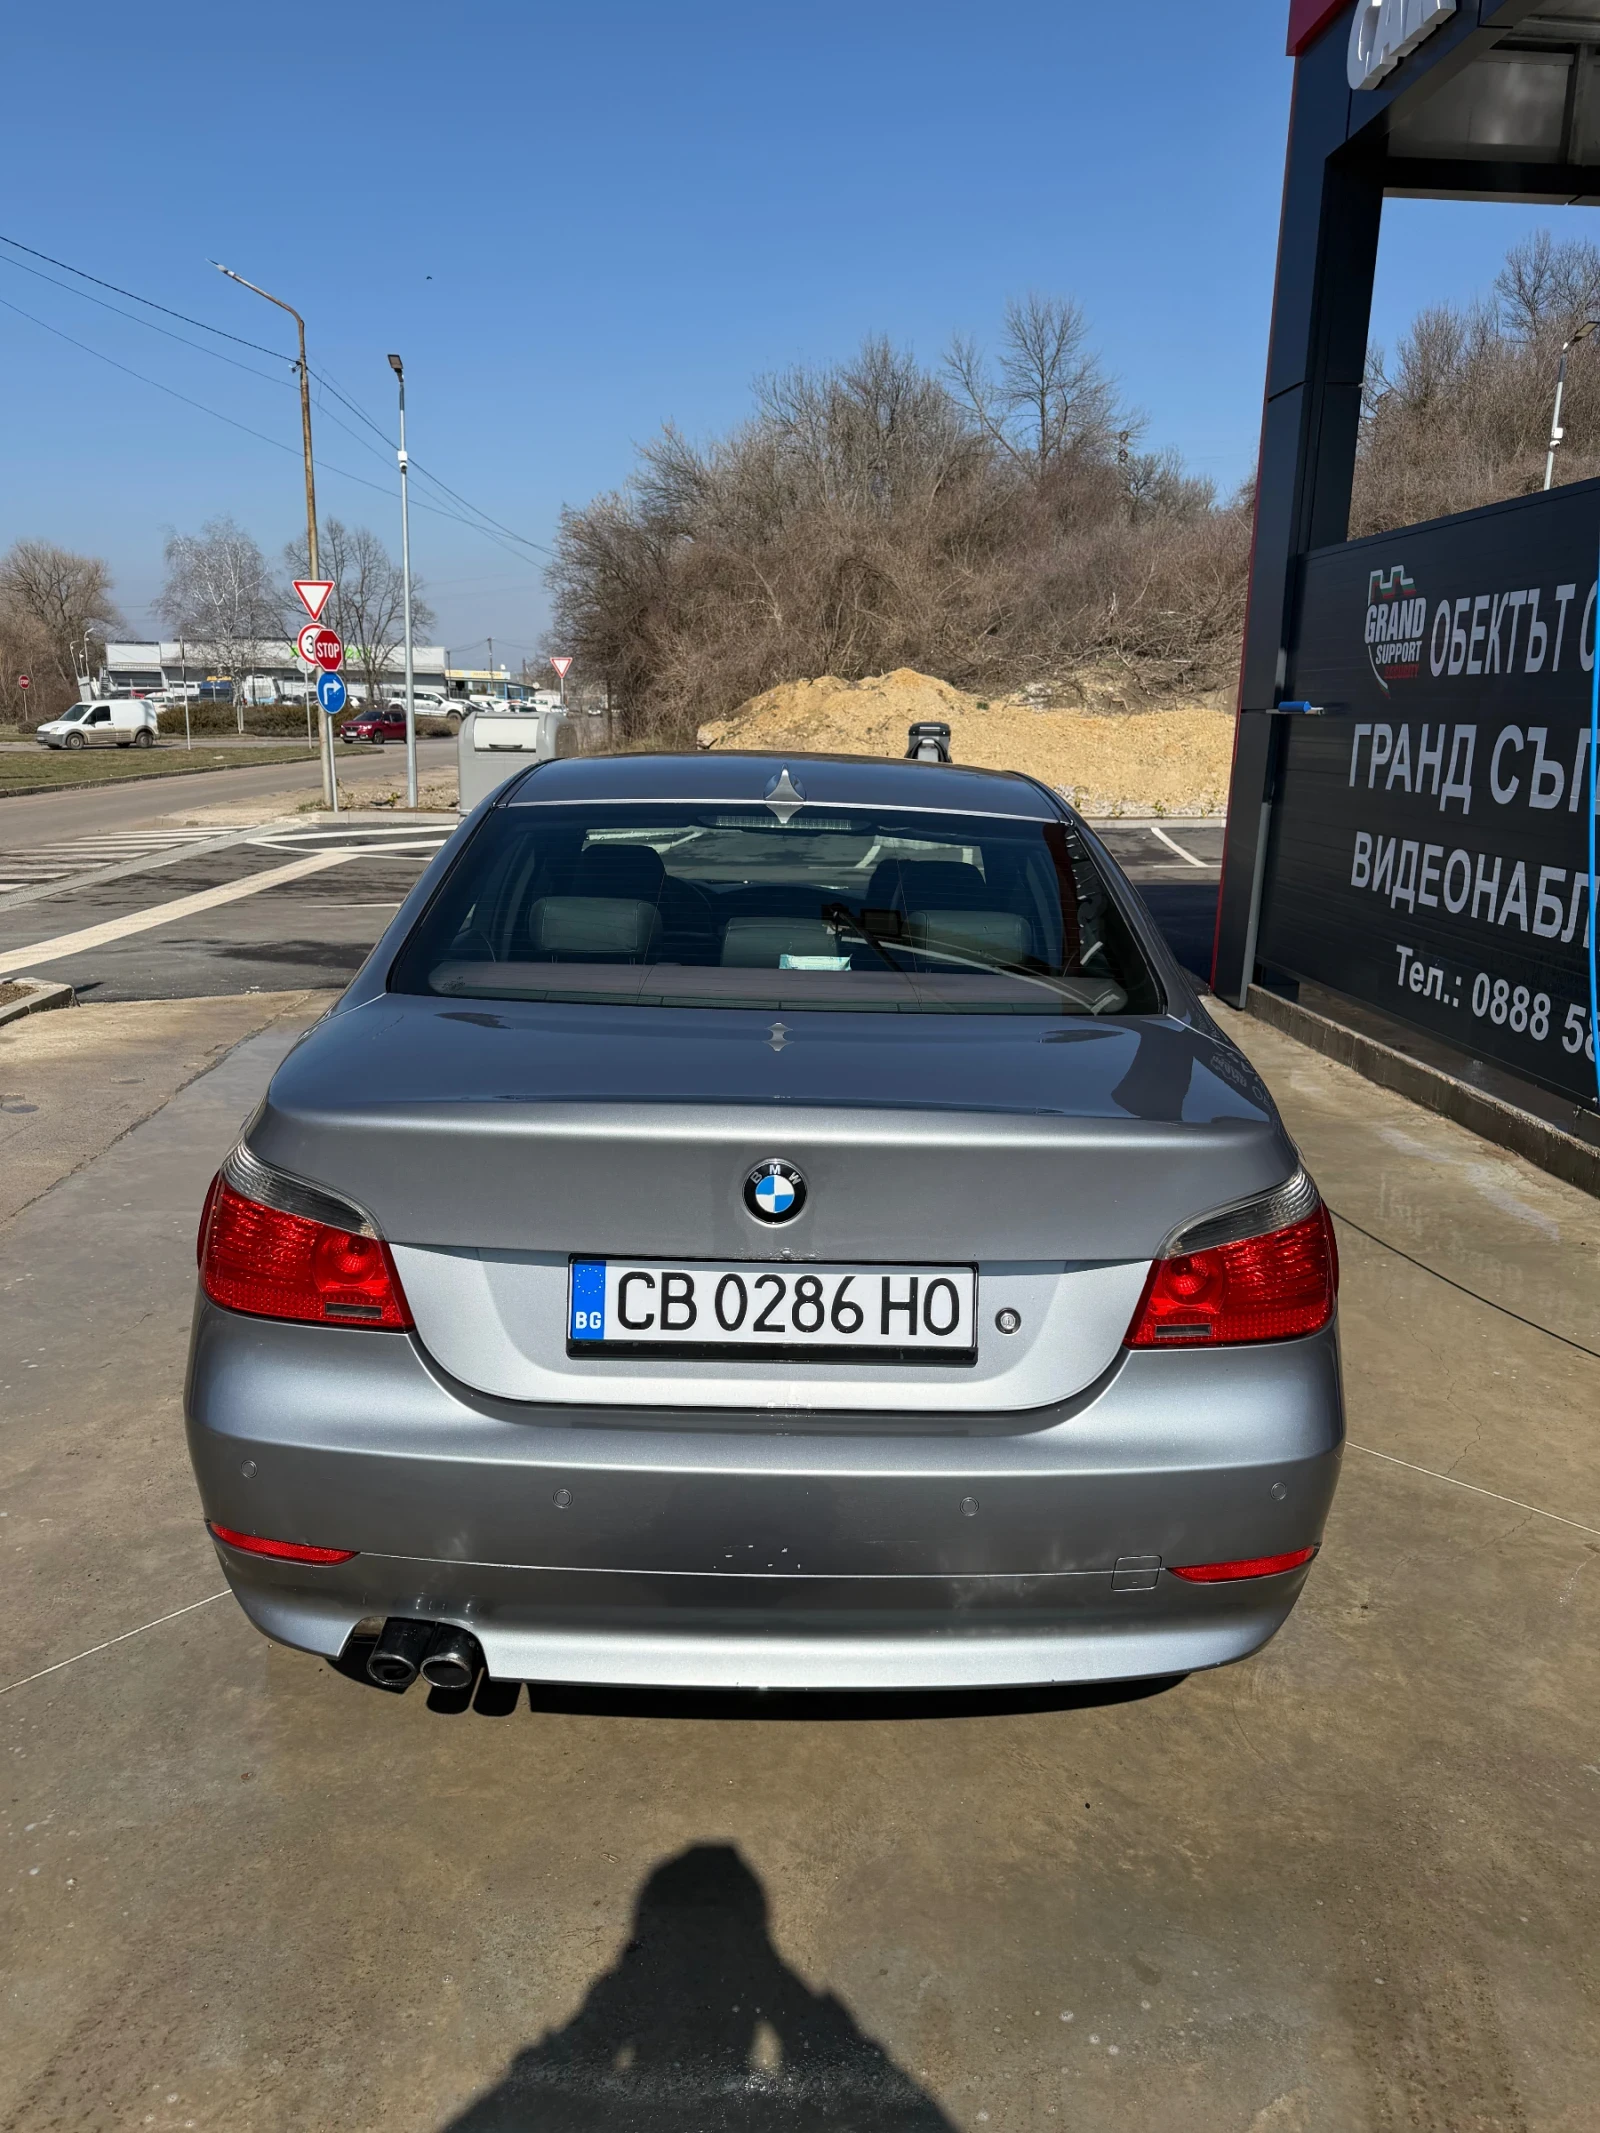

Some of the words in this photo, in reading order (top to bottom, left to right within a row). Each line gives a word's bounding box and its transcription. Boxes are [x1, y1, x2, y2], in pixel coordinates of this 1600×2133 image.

[1364, 597, 1427, 644] GRAND
[1429, 583, 1576, 677] ОБЕКТЪТ
[316, 641, 340, 659] STOP
[1375, 640, 1422, 665] SUPPORT
[1348, 723, 1477, 815] ГРАНД
[1396, 944, 1462, 1008] Тел.:
[1471, 972, 1551, 1041] 0888
[749, 1164, 802, 1185] BMW
[575, 1311, 602, 1330] BG
[617, 1271, 697, 1331] CB
[714, 1273, 864, 1334] 0286
[880, 1276, 960, 1336] HO
